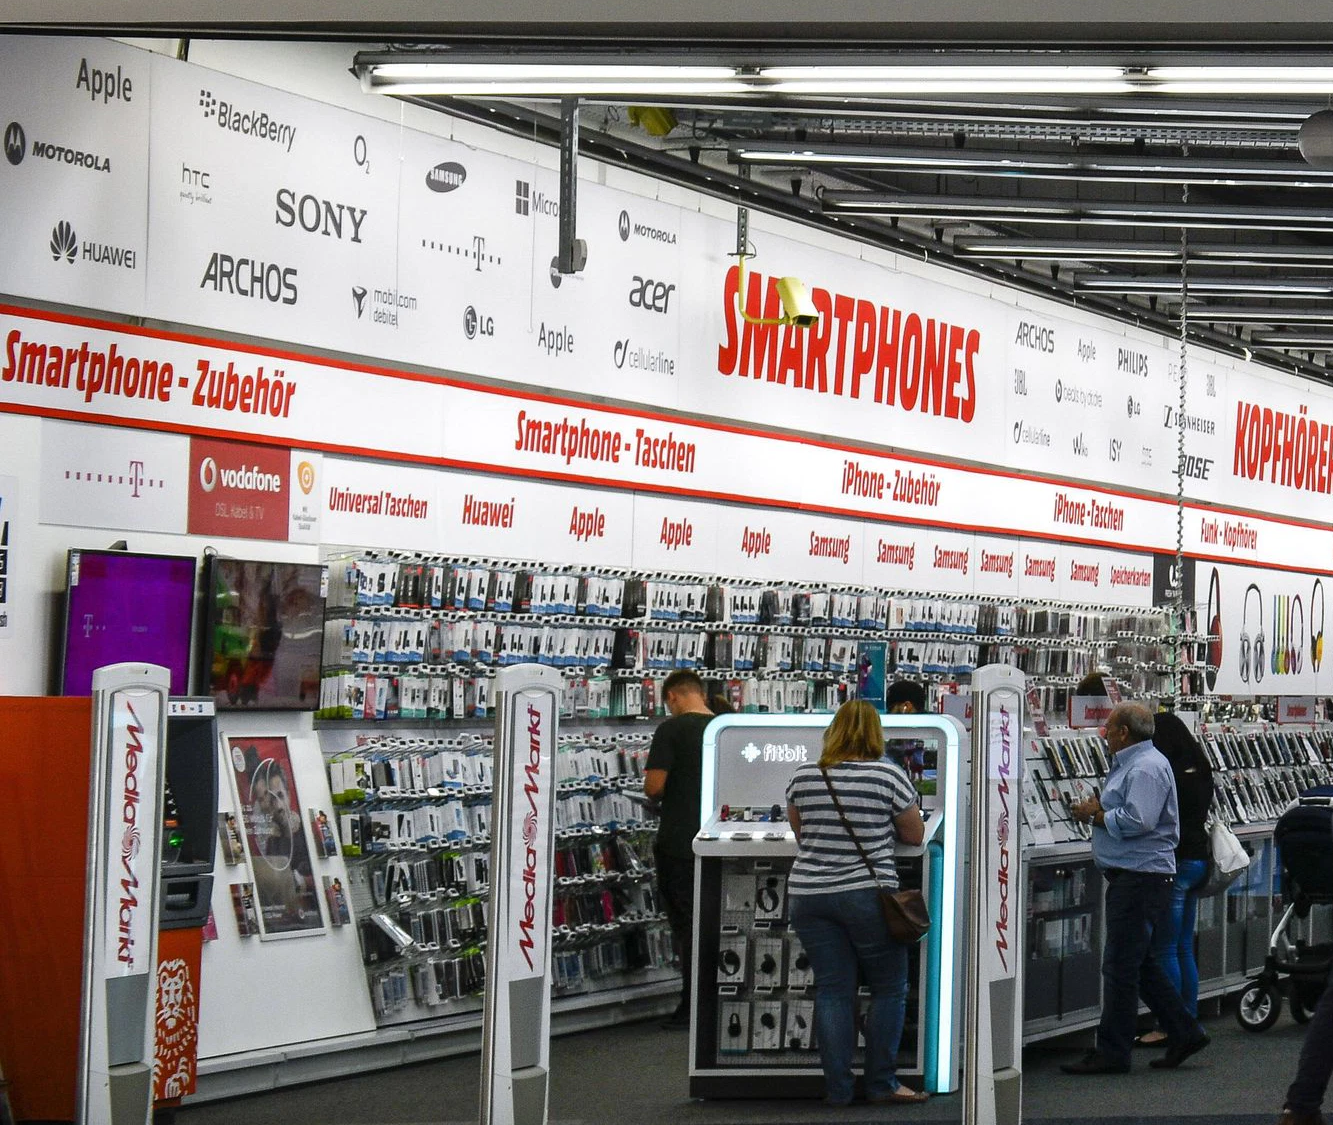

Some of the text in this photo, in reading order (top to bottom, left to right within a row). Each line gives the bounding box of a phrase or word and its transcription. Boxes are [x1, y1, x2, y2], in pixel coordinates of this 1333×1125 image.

[76, 58, 132, 103] Apple
[218, 102, 296, 152] BlackBerry
[32, 141, 111, 173] MOTOROLA
[430, 168, 463, 186] SAMSUNG
[275, 188, 366, 244] SONY
[634, 223, 677, 245] MOTOROLA
[82, 242, 136, 269] HUAWEI
[200, 253, 297, 305] ARCHOS
[629, 276, 675, 314] acer
[373, 310, 398, 327] debitel
[480, 315, 493, 336] LG
[538, 322, 573, 356] Apple
[1015, 322, 1054, 353] ARCHOS
[1078, 339, 1096, 362] Apple
[2, 329, 296, 417] Smartphone Zubehör
[1118, 348, 1148, 377] PHILIPS
[1015, 369, 1027, 397] JBL
[1174, 412, 1215, 435] SENHEISER
[515, 410, 696, 473] Smartphone Taschen
[1109, 439, 1122, 461] ISY
[221, 465, 280, 492] vodafone
[841, 459, 941, 507] iPhone Zubehör
[329, 487, 428, 519] Universal Taschen
[462, 494, 515, 528] Huawei
[1054, 491, 1085, 527] iPhone
[569, 506, 604, 541] Apple
[660, 517, 692, 550] Apple
[1201, 517, 1257, 552] Funk Kopfhörer
[741, 526, 771, 558] Apple
[809, 531, 850, 564] Samsung
[877, 539, 915, 570] Samsung
[934, 545, 968, 575] Samsung
[981, 549, 1013, 578] Samsung
[1025, 555, 1055, 582] Samsung
[1071, 560, 1099, 587] Samsung
[1110, 565, 1150, 589] Speicherkarten
[763, 742, 807, 763] fitbit
[116, 700, 145, 970] Media Markt
[517, 704, 544, 973] Media Markt
[996, 848, 1011, 973] Media
